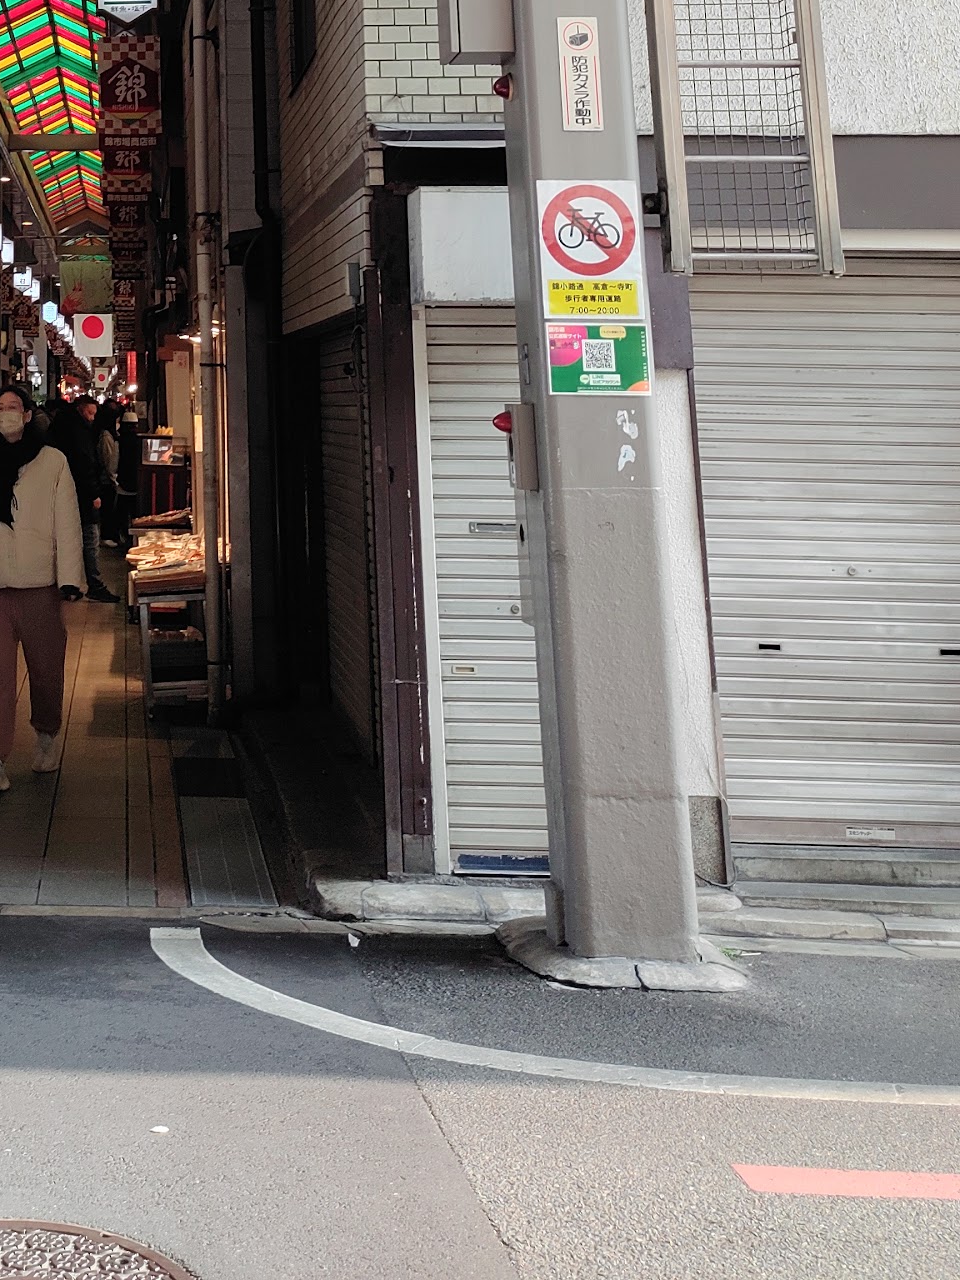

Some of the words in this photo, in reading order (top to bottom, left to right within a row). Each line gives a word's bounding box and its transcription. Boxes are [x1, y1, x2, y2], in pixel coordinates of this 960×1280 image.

[107, 64, 147, 112] 錦
[571, 55, 592, 126] 防犯カメラ作動中
